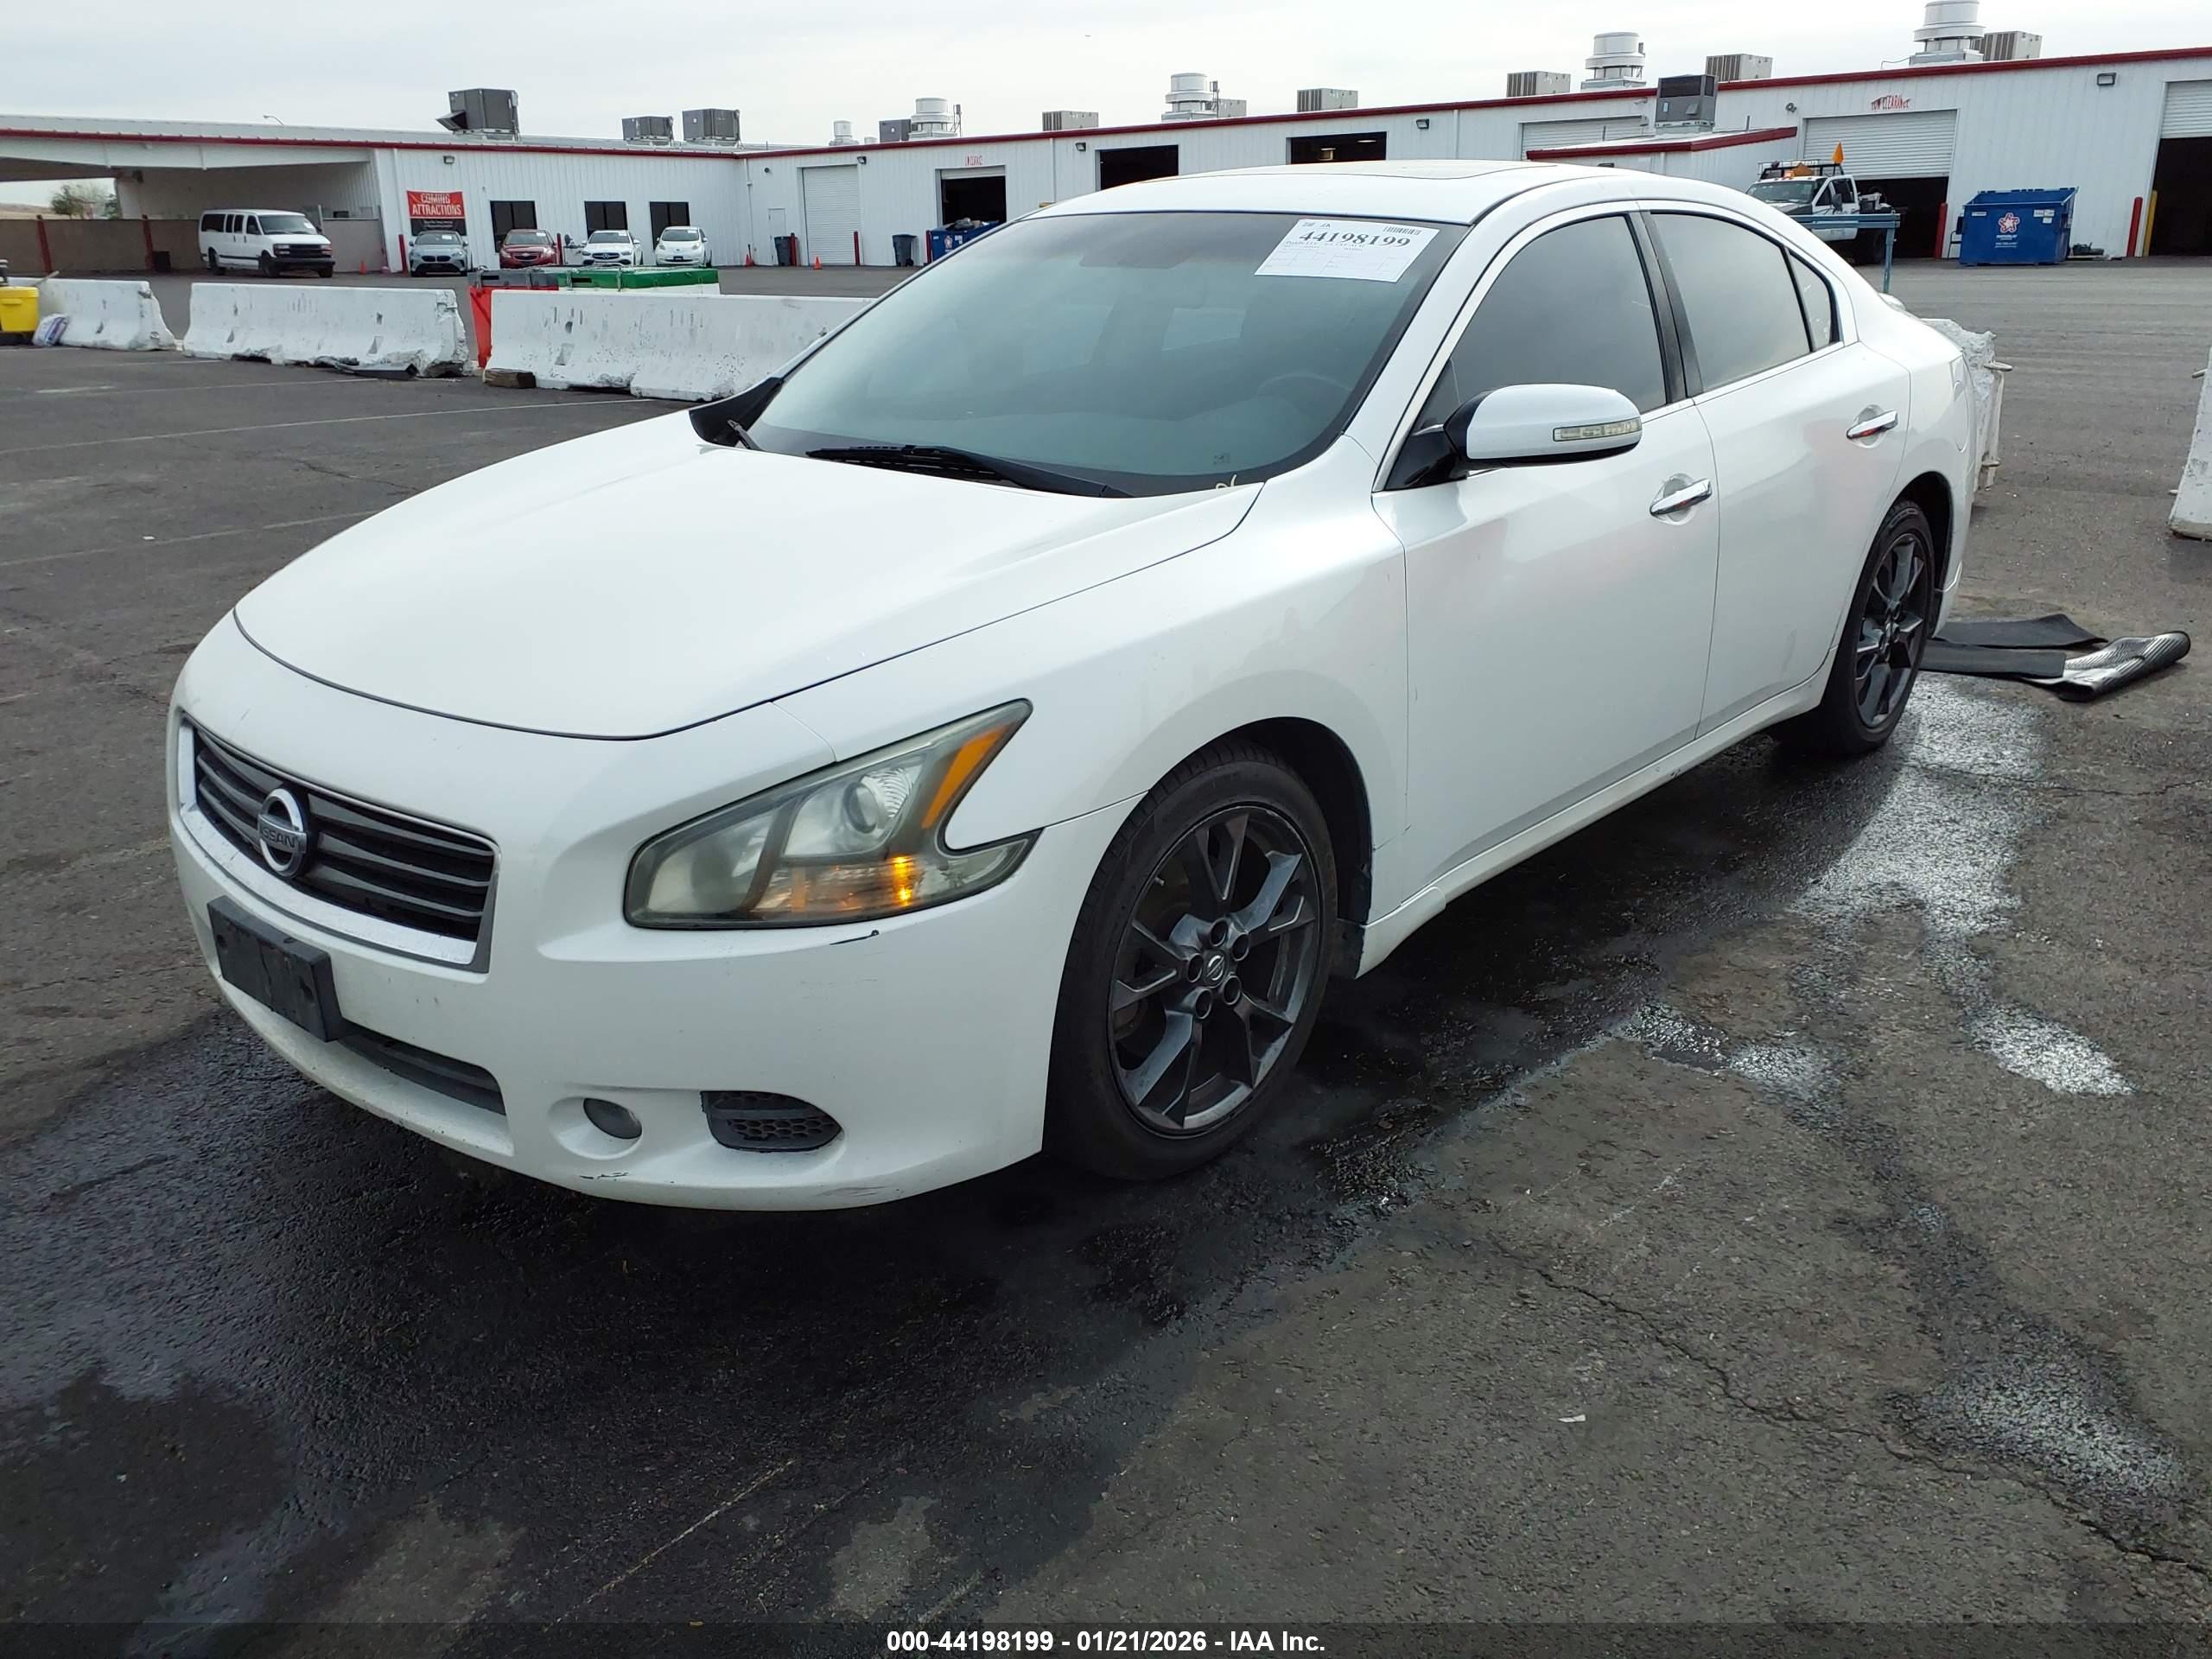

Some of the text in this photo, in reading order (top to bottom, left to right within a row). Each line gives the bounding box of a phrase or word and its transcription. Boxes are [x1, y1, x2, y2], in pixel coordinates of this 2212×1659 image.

[421, 193, 450, 203] COMING
[412, 204, 461, 215] ATTRACTIONS
[1300, 232, 1411, 246] 44198199
[261, 826, 295, 848] SSAN
